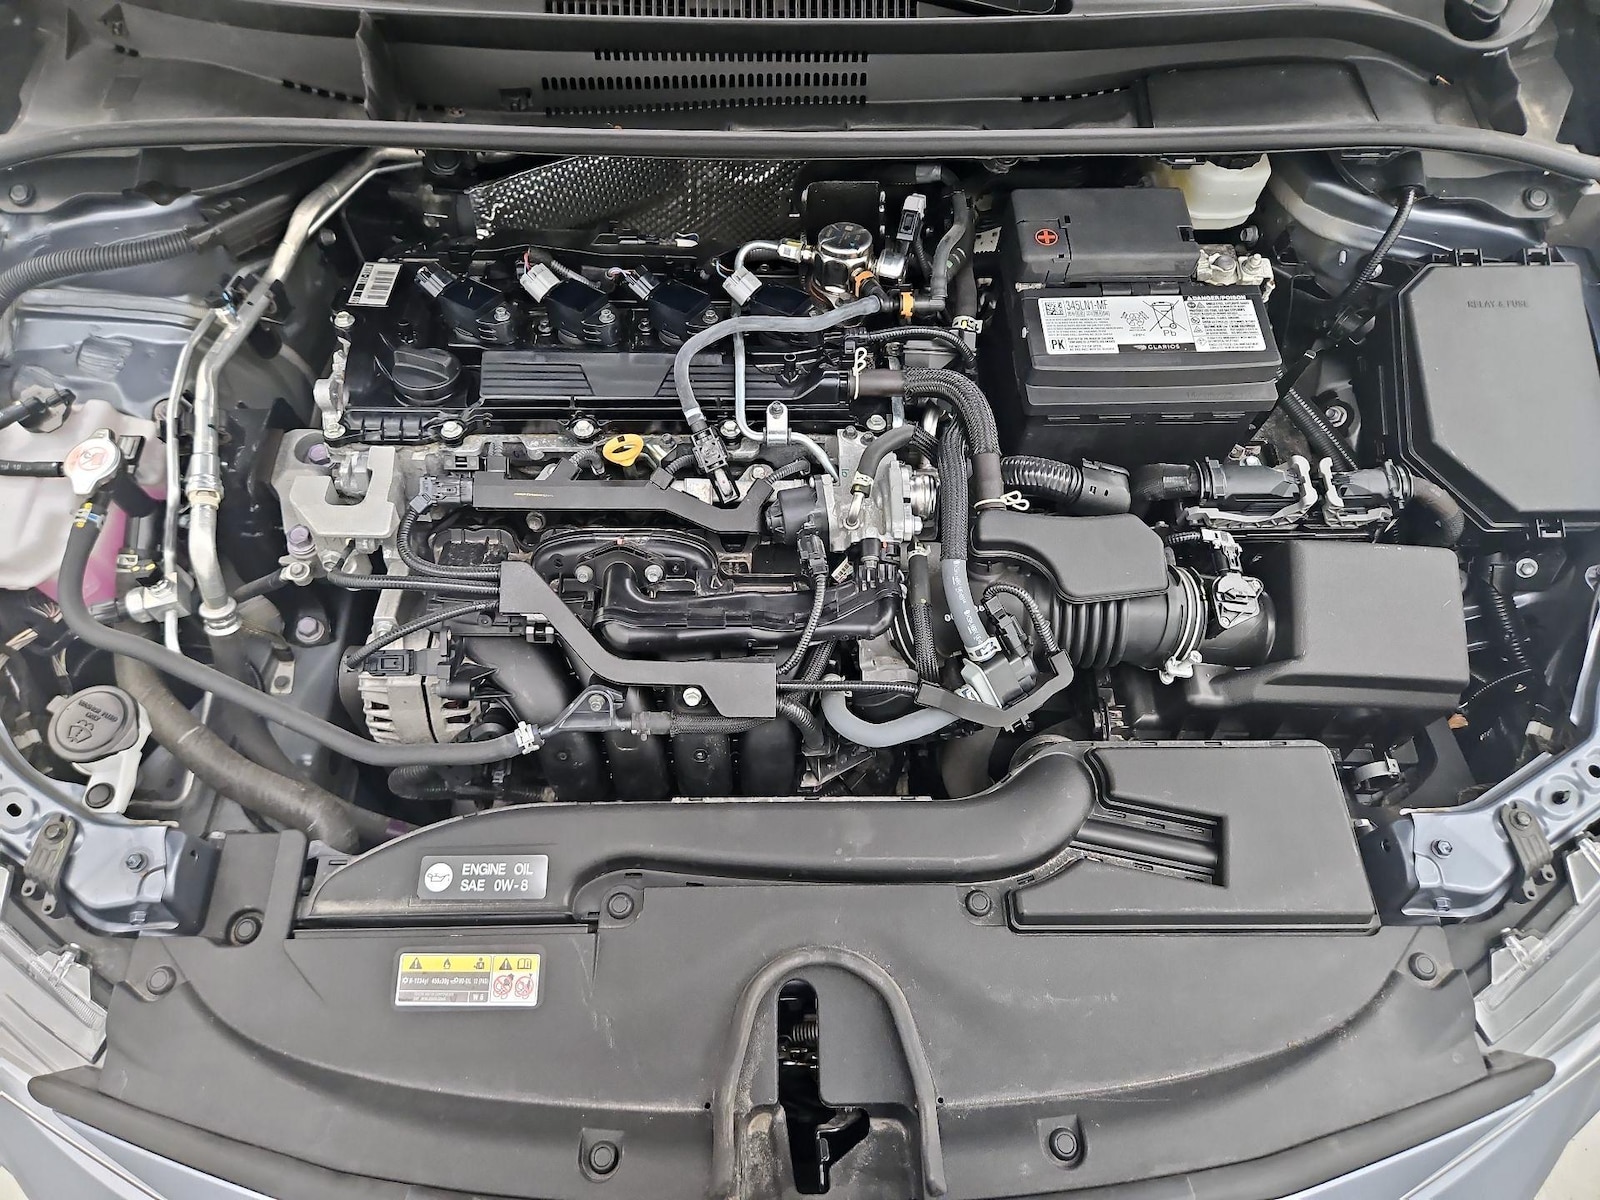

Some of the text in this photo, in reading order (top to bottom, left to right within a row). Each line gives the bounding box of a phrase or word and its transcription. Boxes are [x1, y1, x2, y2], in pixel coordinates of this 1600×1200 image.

[1163, 329, 1177, 337] Pb
[1051, 339, 1065, 350] PK
[461, 863, 534, 876] ENGINE OIL
[460, 879, 529, 892] SAE 0W-8
